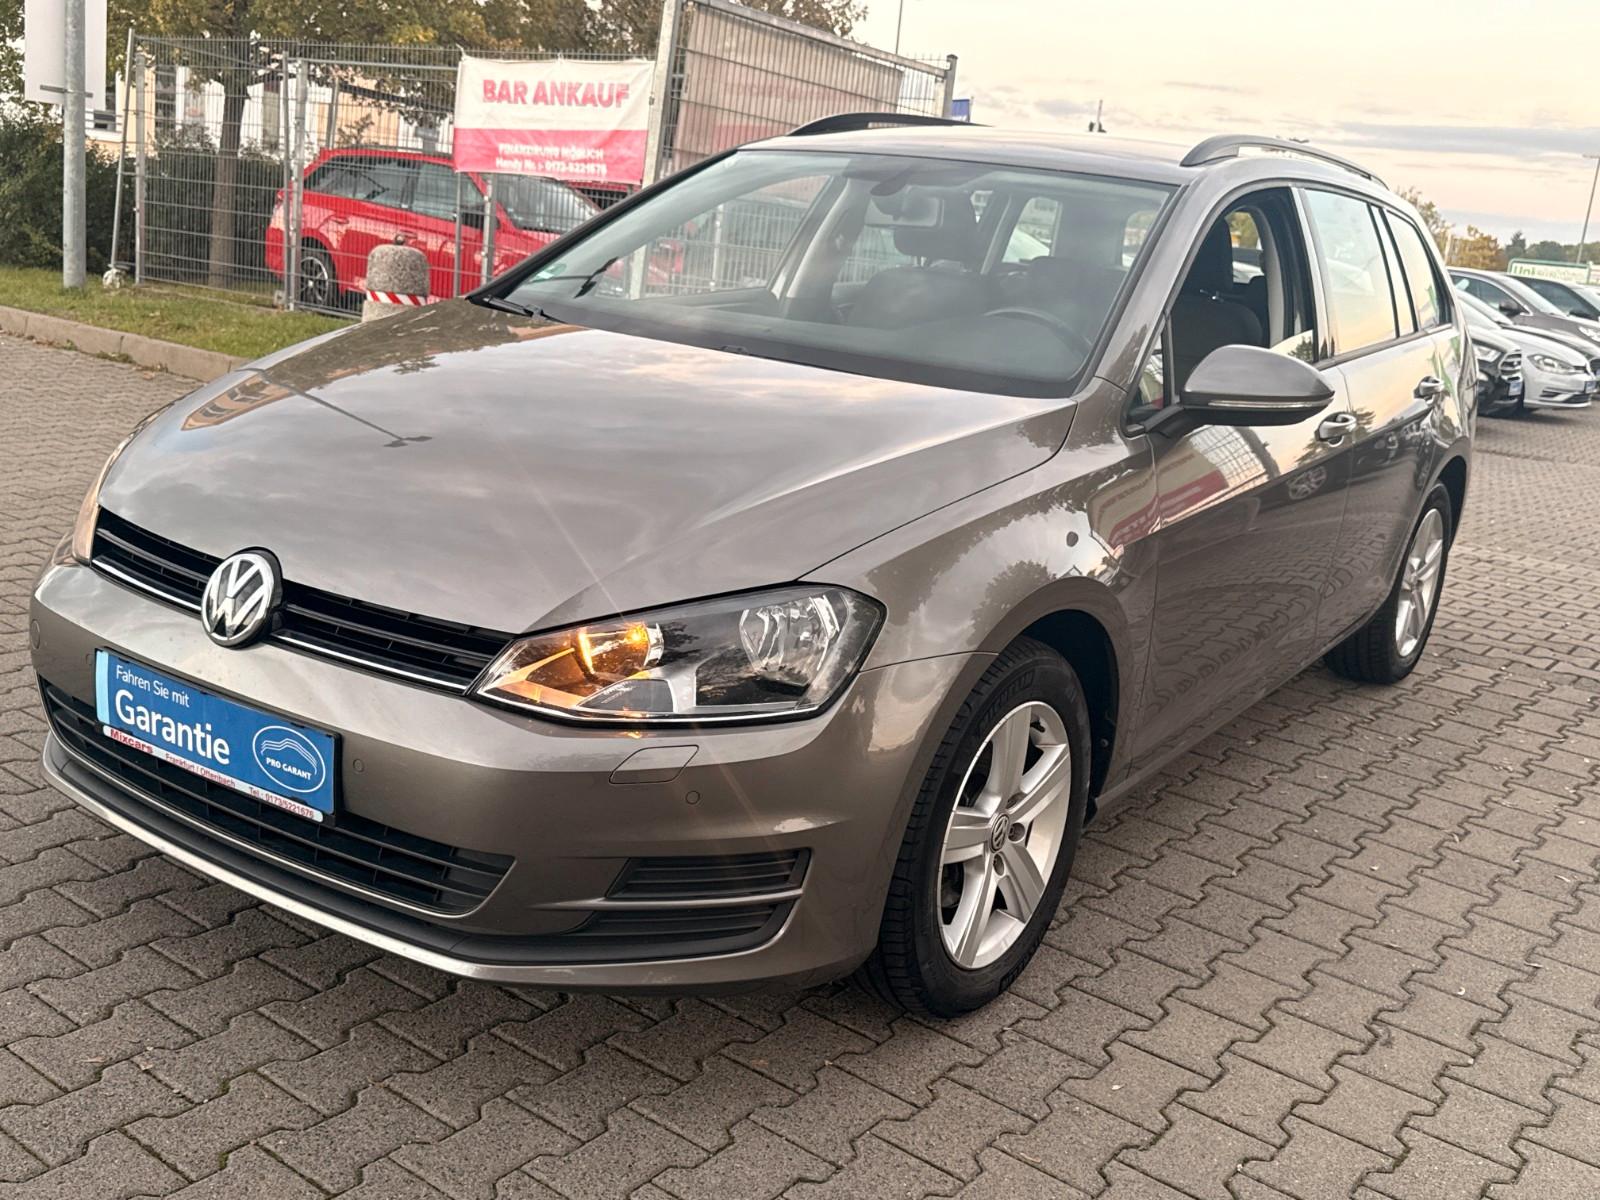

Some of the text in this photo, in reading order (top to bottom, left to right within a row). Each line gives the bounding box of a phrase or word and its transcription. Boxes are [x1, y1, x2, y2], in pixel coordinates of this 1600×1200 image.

[483, 79, 630, 108] BAR ANKAUF
[496, 157, 522, 171] Handy
[116, 664, 190, 708] Fahren Sie mit
[115, 689, 230, 765] Garantie
[110, 729, 153, 754] Mixcars
[165, 753, 195, 770] Frankfurt
[200, 768, 235, 788] Offenbach
[265, 757, 312, 780] PRO GARANT
